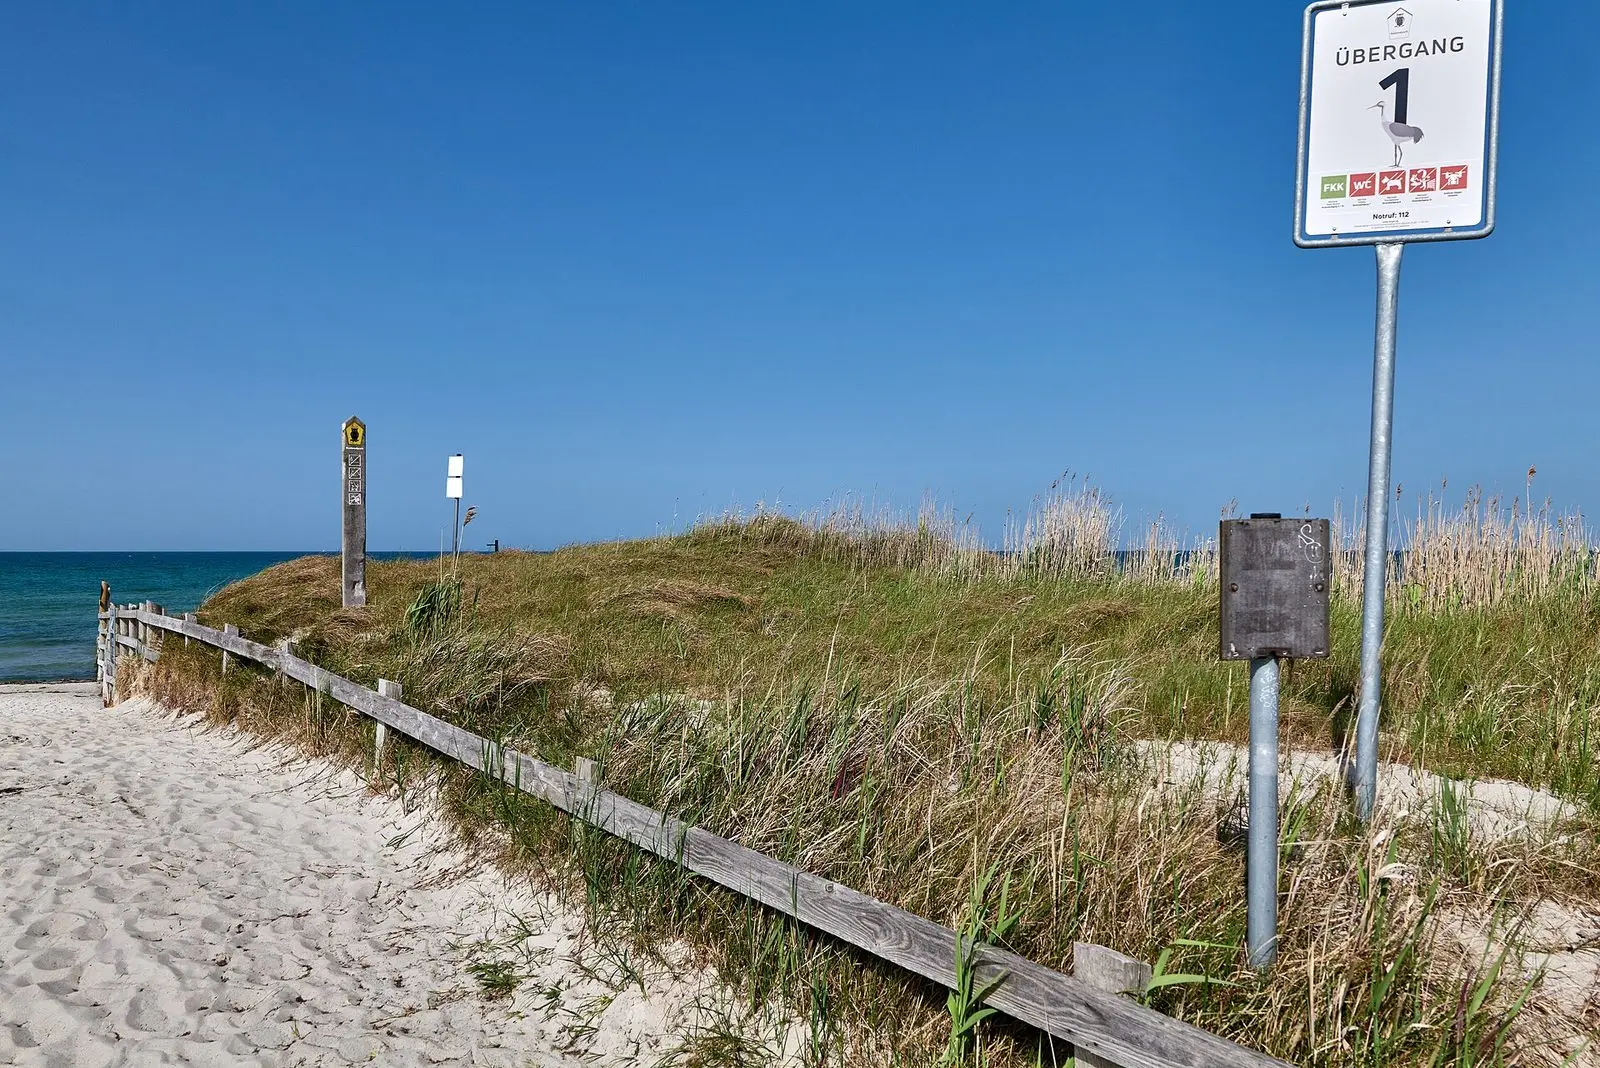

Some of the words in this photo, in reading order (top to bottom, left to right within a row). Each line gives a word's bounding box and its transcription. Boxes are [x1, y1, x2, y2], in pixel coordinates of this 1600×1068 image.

[1336, 36, 1465, 66] ÜBERGANG
[1378, 68, 1409, 125] 1
[1323, 182, 1345, 192] FKK
[1353, 180, 1372, 190] WC
[1372, 212, 1397, 220] Notruf:
